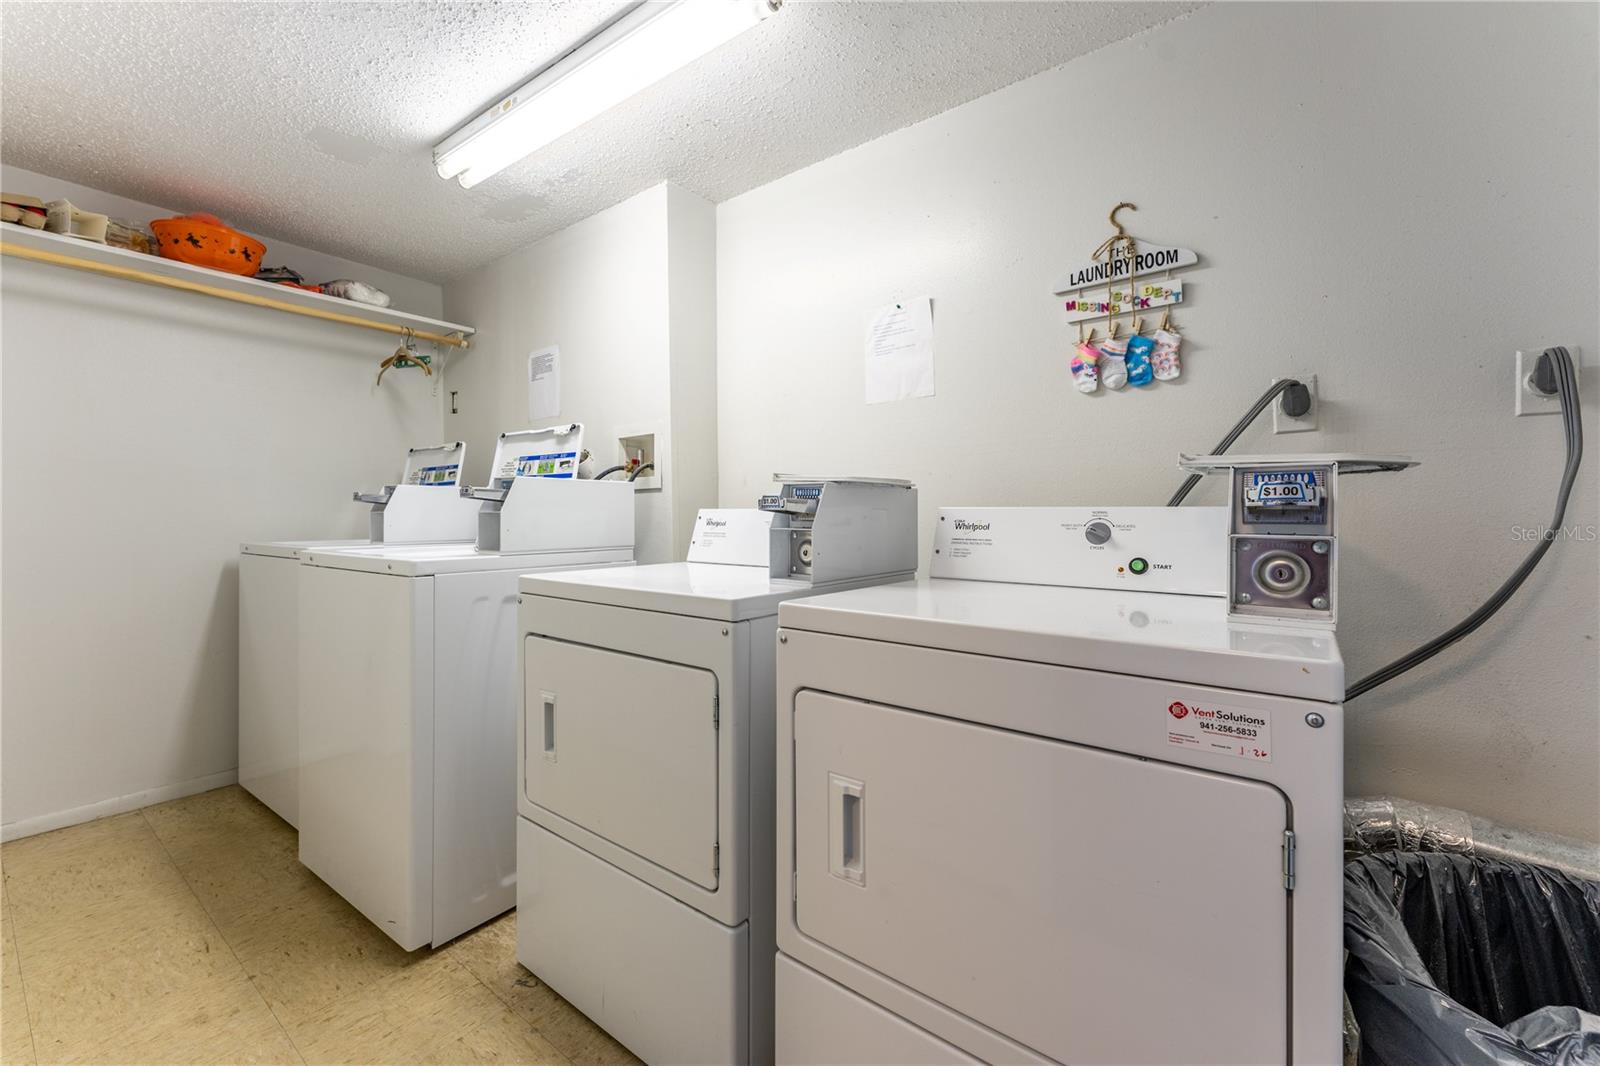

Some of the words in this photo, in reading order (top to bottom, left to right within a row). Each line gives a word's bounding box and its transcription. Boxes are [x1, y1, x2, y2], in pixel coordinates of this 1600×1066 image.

[1070, 258, 1130, 286] LAUNDRY
[1135, 249, 1179, 272] ROOM
[1066, 299, 1121, 314] MISSING
[1112, 291, 1151, 308] SOCK
[1143, 284, 1182, 302] DEPT
[1263, 486, 1299, 496] $1.00
[955, 522, 990, 532] Whirlpool
[1199, 721, 1257, 737] 941-256-5833
